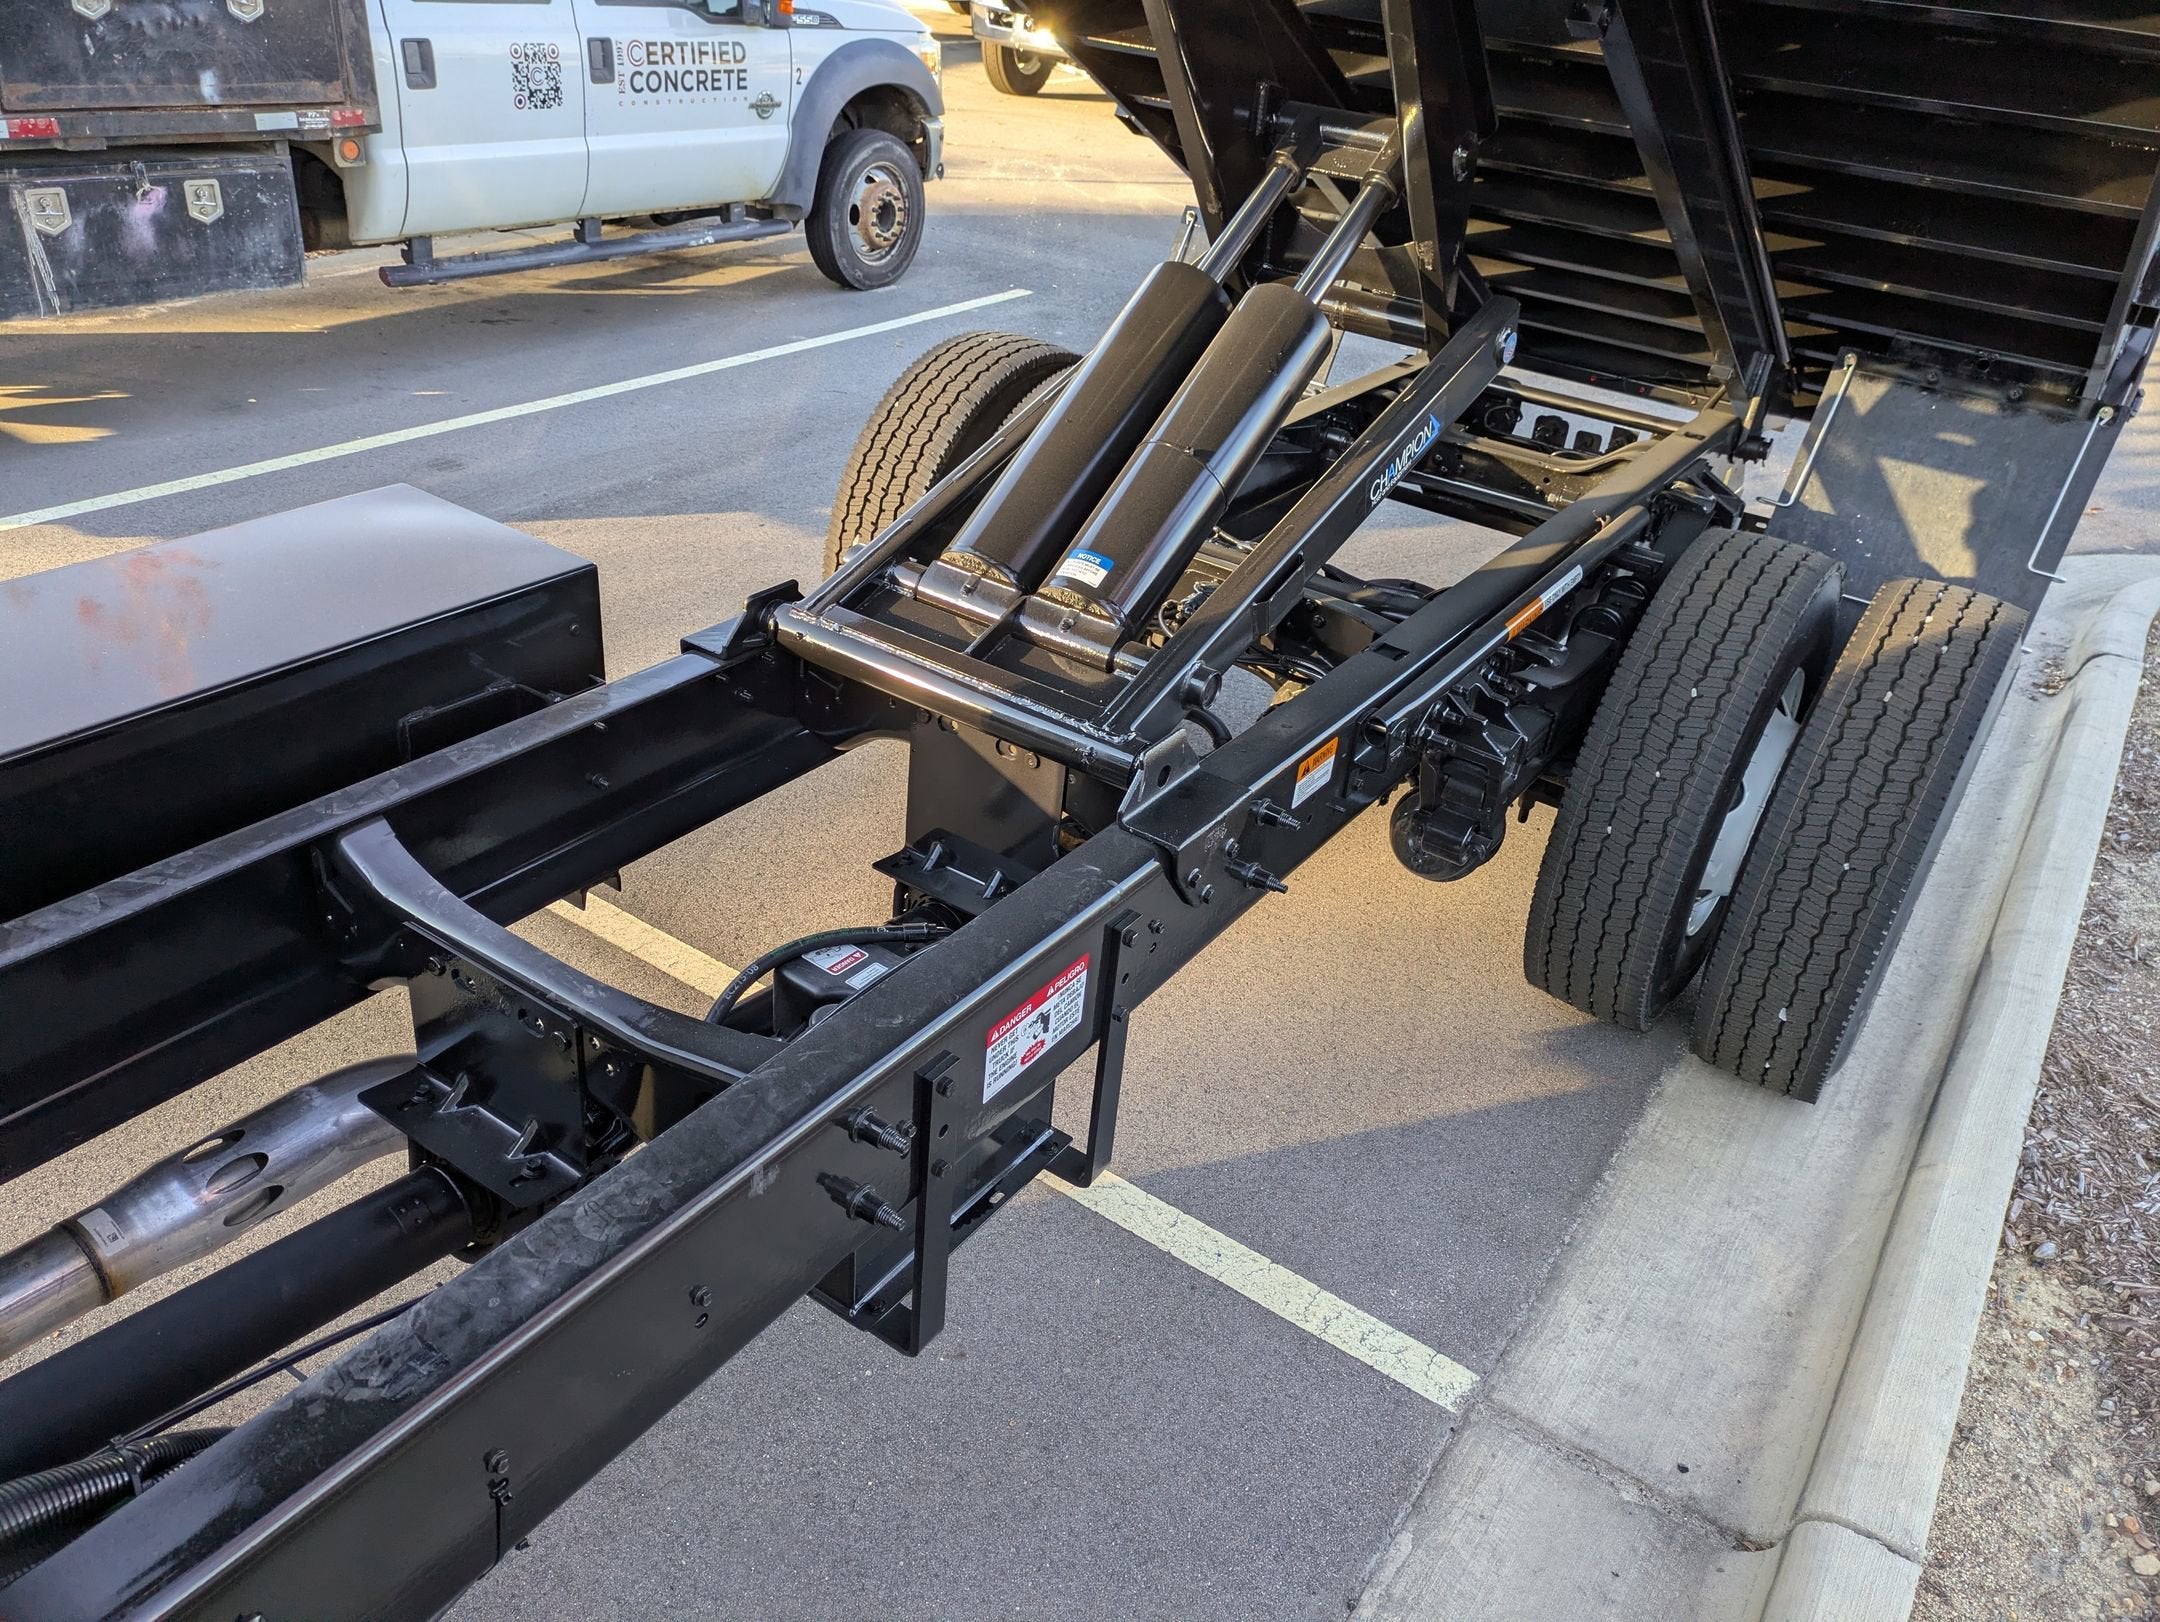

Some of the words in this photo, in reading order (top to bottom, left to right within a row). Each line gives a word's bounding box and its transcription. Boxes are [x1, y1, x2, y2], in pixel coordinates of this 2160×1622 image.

[616, 41, 624, 65] 1997
[627, 40, 746, 67] CERTIFIED
[630, 69, 748, 93] CONCRETE
[796, 67, 802, 86] 2
[619, 97, 748, 106] CONSTRUCTION
[1370, 420, 1433, 500] CHAMPION
[1077, 552, 1101, 565] NOTICE
[1055, 961, 1085, 991] PELIGRO
[999, 1004, 1032, 1036] DANGER
[989, 1045, 1007, 1063] UNDER
[1008, 1035, 1019, 1048] THIS
[991, 1035, 1008, 1054] NEVER
[1009, 1026, 1019, 1039] GET
[989, 1067, 998, 1080] THE
[999, 1051, 1017, 1071] ENGINE
[993, 1052, 1009, 1069] TRUCK
